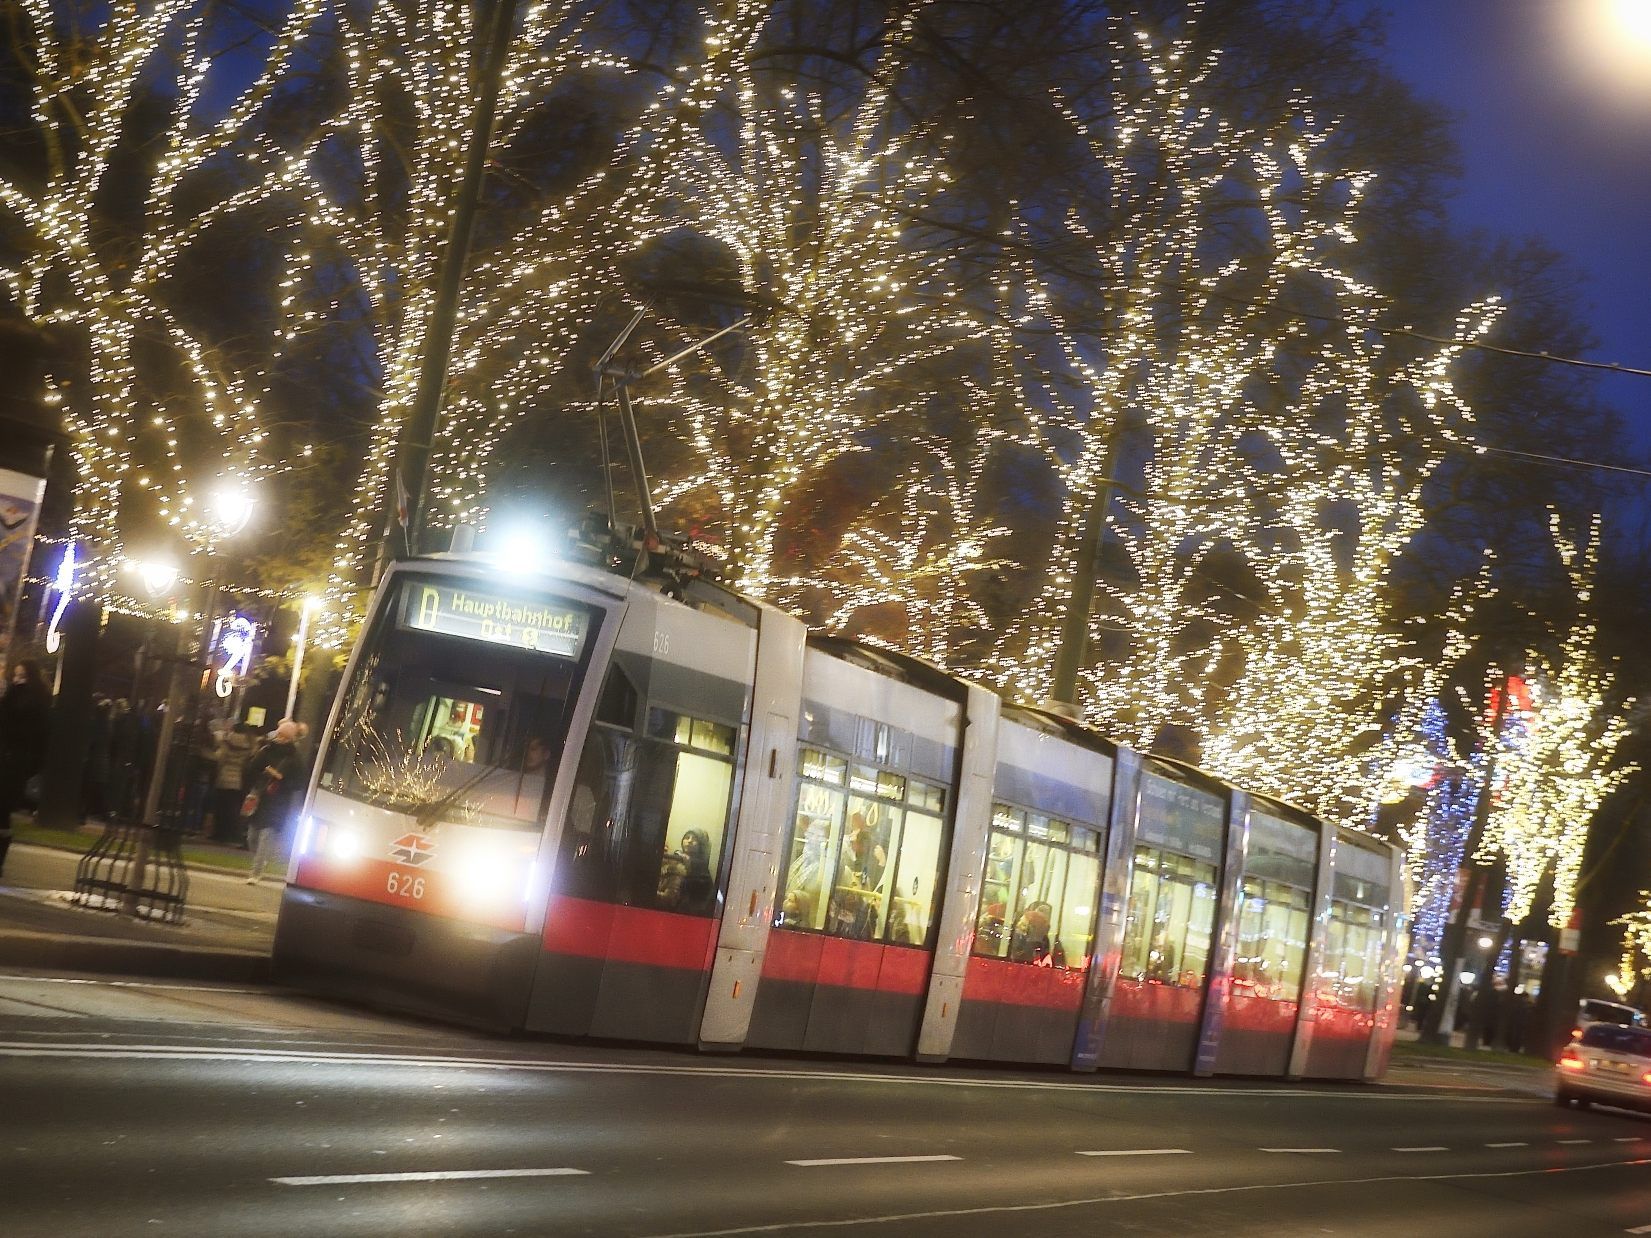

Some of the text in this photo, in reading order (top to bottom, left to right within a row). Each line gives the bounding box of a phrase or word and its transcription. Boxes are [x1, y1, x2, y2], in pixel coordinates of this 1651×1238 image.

[418, 587, 573, 629] D Hauptbahnhof
[653, 631, 670, 655] 626
[387, 872, 426, 899] 626
